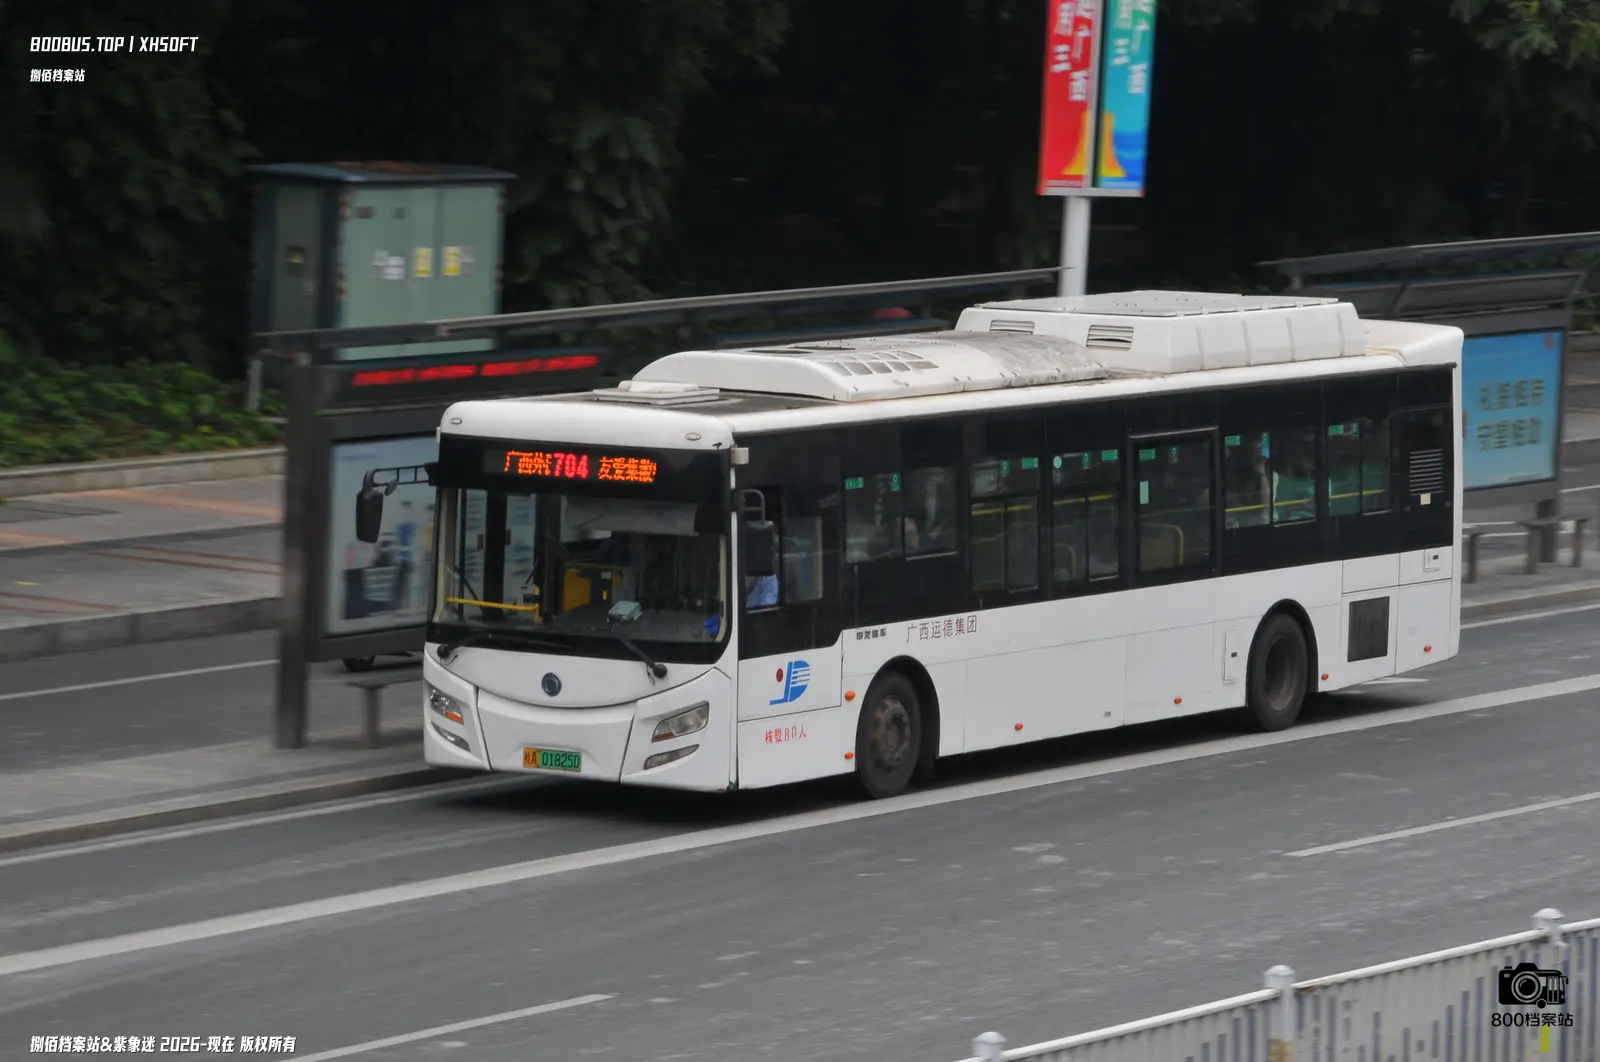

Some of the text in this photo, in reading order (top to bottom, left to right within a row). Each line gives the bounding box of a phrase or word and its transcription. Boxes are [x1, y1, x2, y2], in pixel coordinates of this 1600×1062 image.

[552, 451, 589, 479] 704
[906, 614, 977, 643] 广西运德集团
